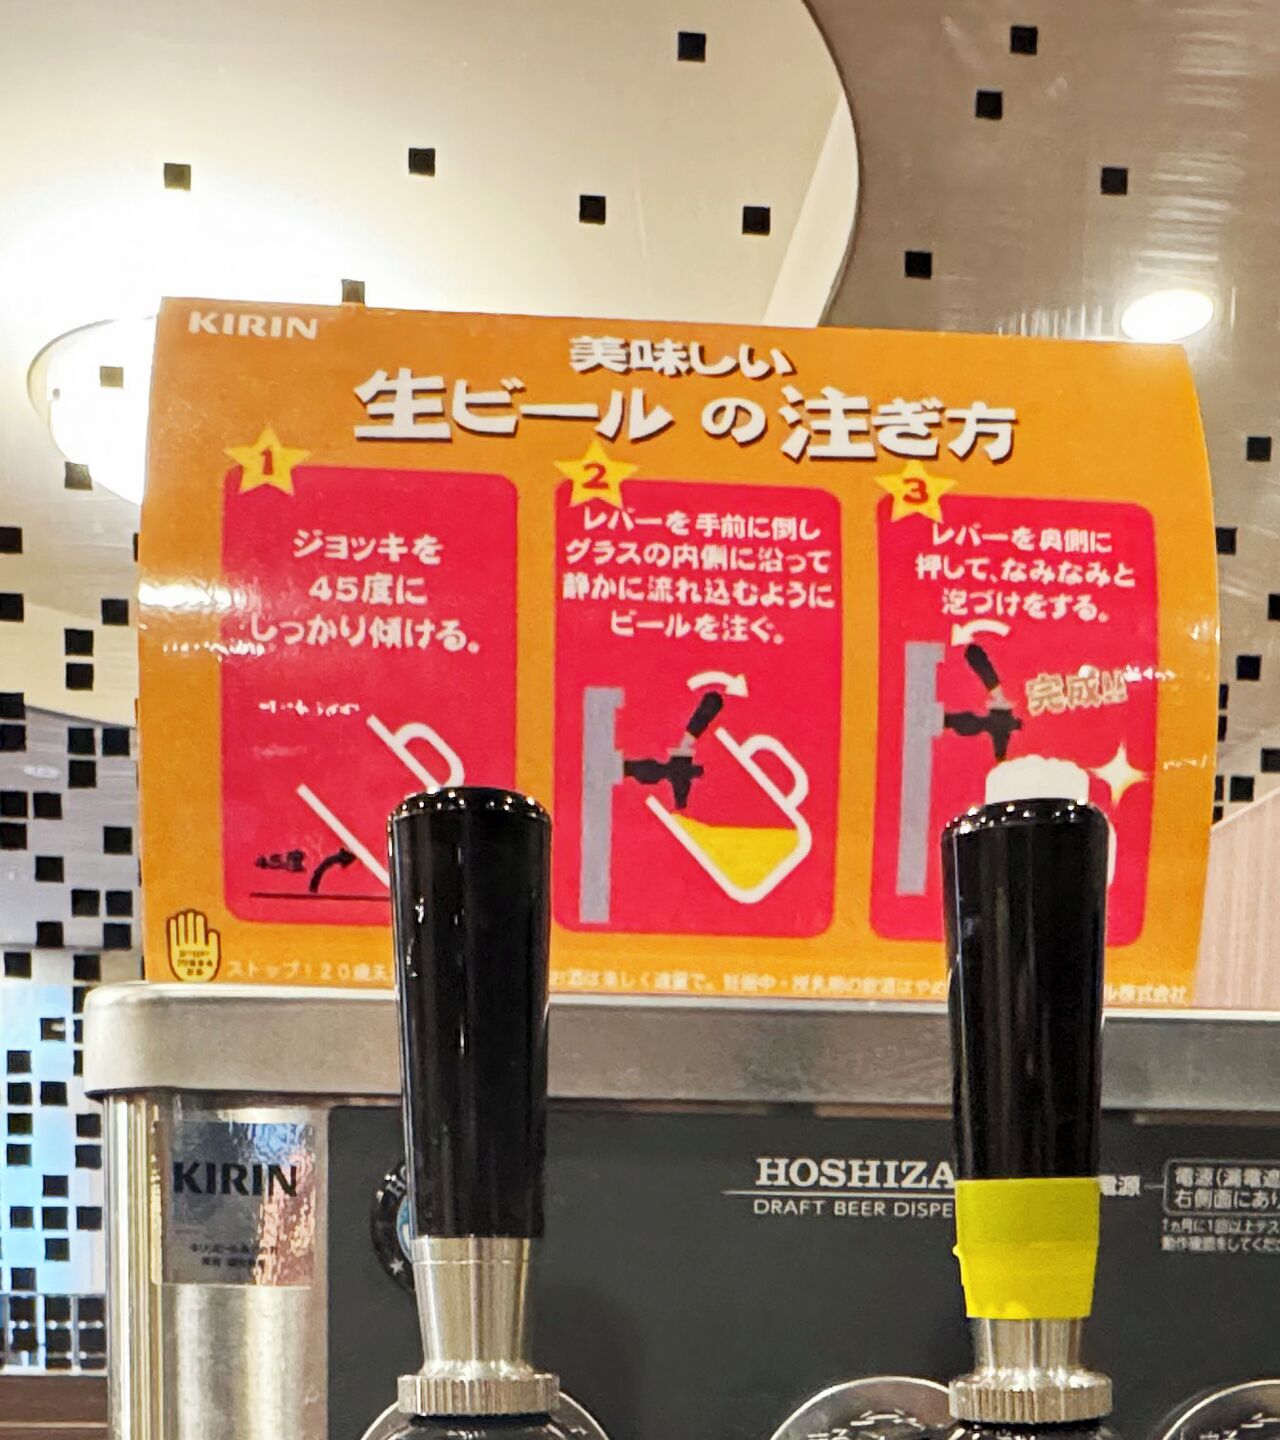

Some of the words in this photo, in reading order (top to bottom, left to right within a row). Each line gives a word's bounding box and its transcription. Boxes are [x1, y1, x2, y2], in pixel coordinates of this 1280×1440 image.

[188, 310, 318, 340] KIRIN
[569, 336, 797, 380] 美味しい
[261, 447, 274, 476] 1
[582, 462, 610, 489] 2
[902, 478, 929, 505] 3
[292, 529, 444, 565] ジョッキを
[564, 540, 832, 575] グラスの内側に沿って
[309, 572, 428, 605] 45度に
[562, 574, 836, 611] 静かに流れ込むように
[941, 588, 1110, 623] 泡づけをする。
[250, 614, 481, 655] しっかり傾ける。
[610, 610, 785, 646] ビールを注ぐ。
[173, 1161, 297, 1197] KIRIN
[755, 1157, 955, 1189] HOSHIZA
[753, 1198, 827, 1215] DRAFT
[833, 1200, 886, 1216] BEER
[893, 1202, 954, 1218] DISPE
